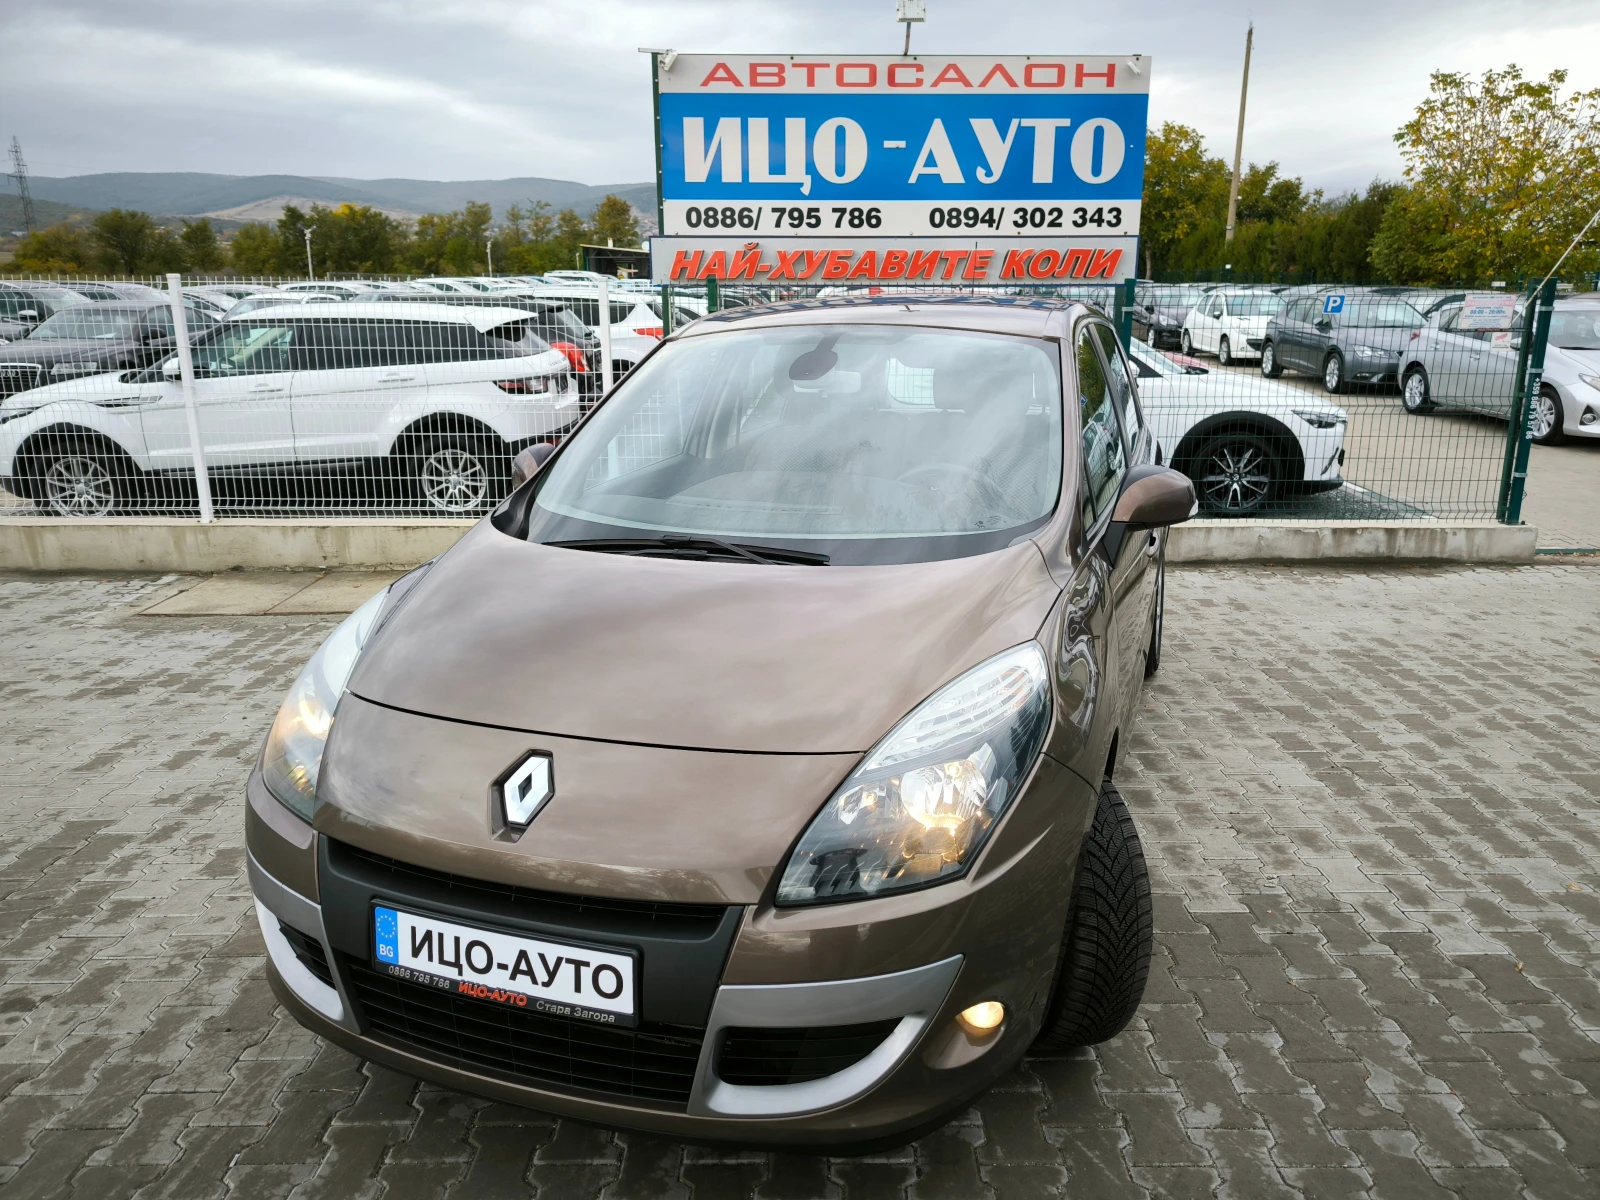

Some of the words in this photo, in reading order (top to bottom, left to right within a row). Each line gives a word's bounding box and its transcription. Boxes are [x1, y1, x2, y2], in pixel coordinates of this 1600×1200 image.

[700, 62, 1116, 88] АВТОСАЛОН
[685, 206, 762, 230] 0886/
[771, 207, 821, 229] 795
[831, 207, 882, 229] 786
[929, 206, 1005, 230] 0894/
[1012, 207, 1063, 228] 302
[1072, 207, 1122, 228] 343
[668, 242, 995, 280] НАЙ-ХУБАВИТЕ
[999, 248, 1123, 280] КОЛИ
[1327, 296, 1341, 312] P
[379, 944, 394, 958] BG
[410, 925, 624, 1000] ИЦО-АУТО
[388, 965, 411, 979] 0886
[413, 972, 430, 984] 795
[433, 977, 450, 989] 786
[458, 980, 528, 1006] ИЦО-АУТО
[536, 1000, 571, 1015] Стара
[573, 1006, 616, 1023] Загора
